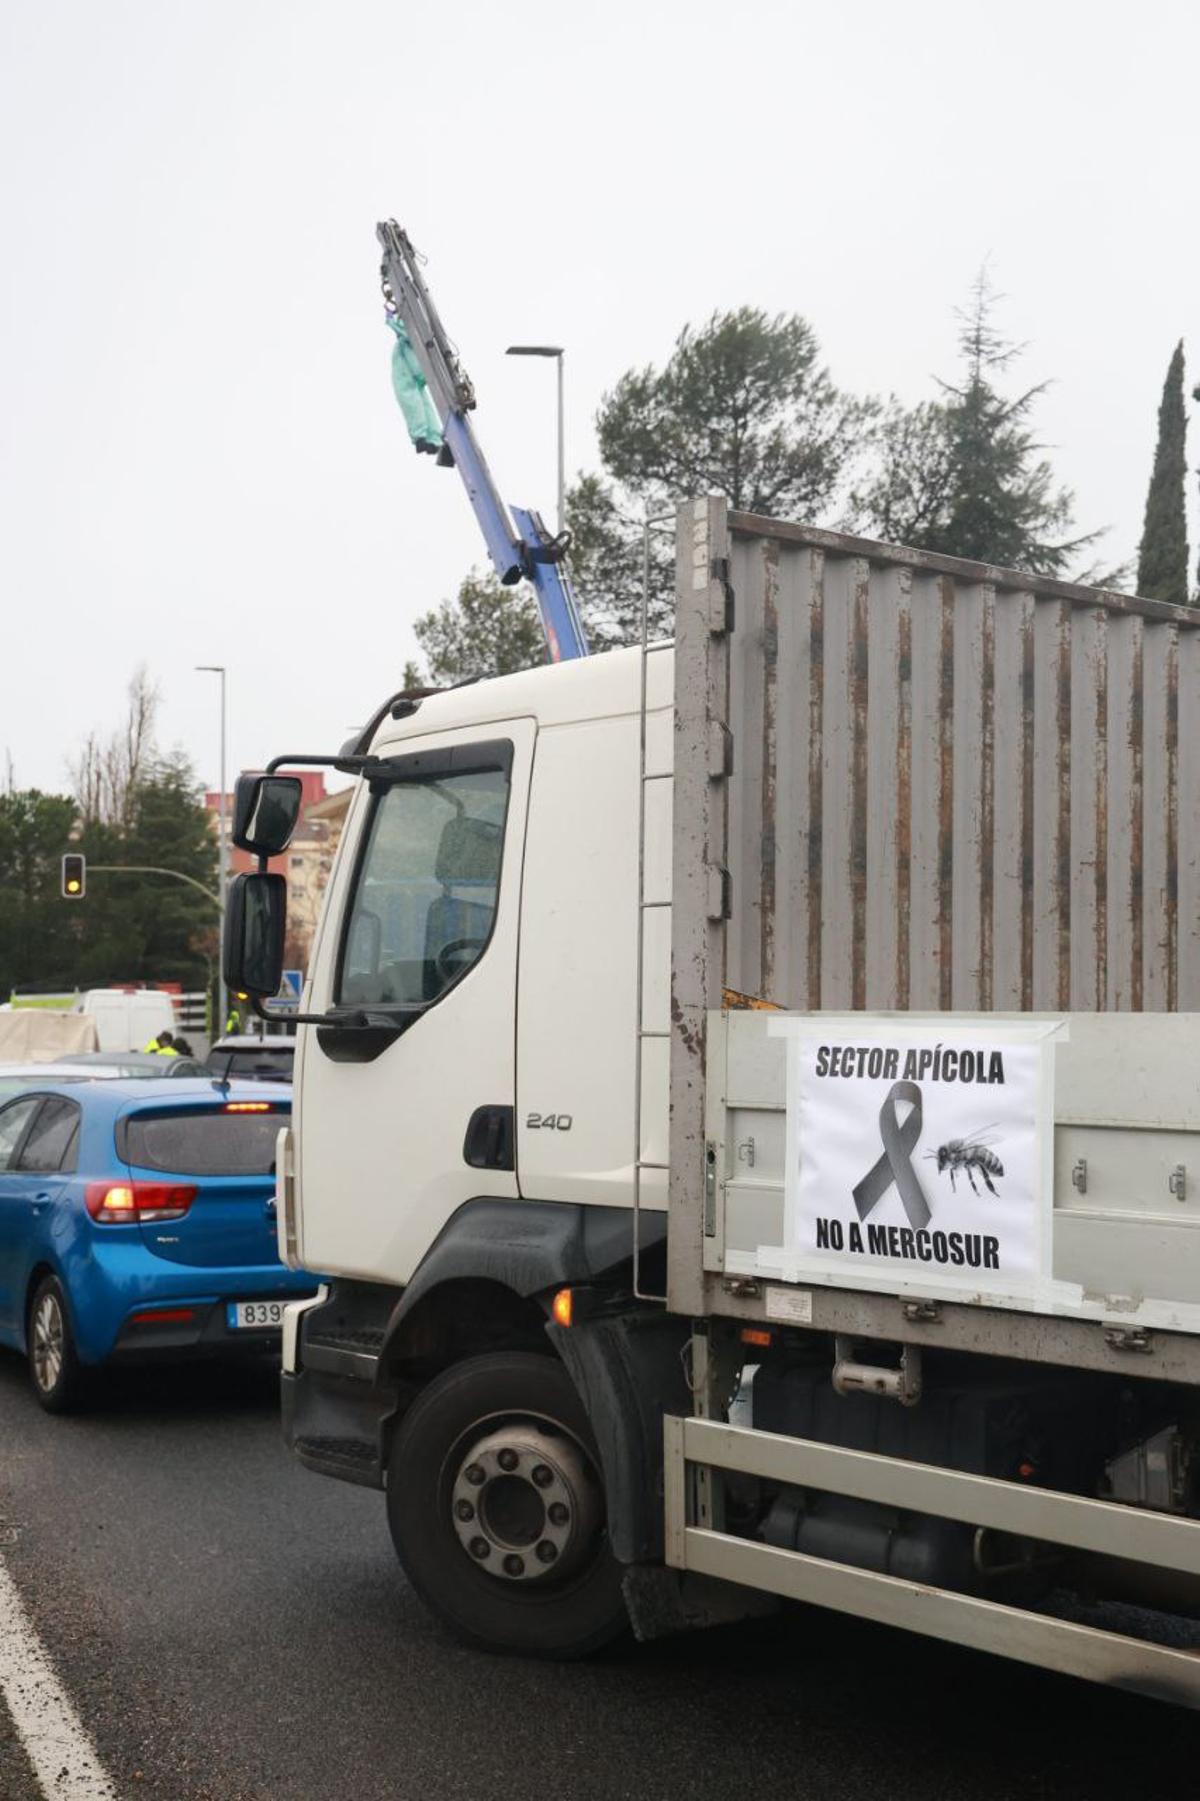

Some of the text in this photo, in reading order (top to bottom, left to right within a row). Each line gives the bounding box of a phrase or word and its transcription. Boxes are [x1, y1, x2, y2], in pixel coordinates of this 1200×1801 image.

[815, 1043, 1005, 1084] SECTOR APÍCOLA
[526, 1112, 573, 1131] 240
[816, 1217, 1000, 1270] NO A MERCOSUR
[245, 1303, 288, 1324] 839
